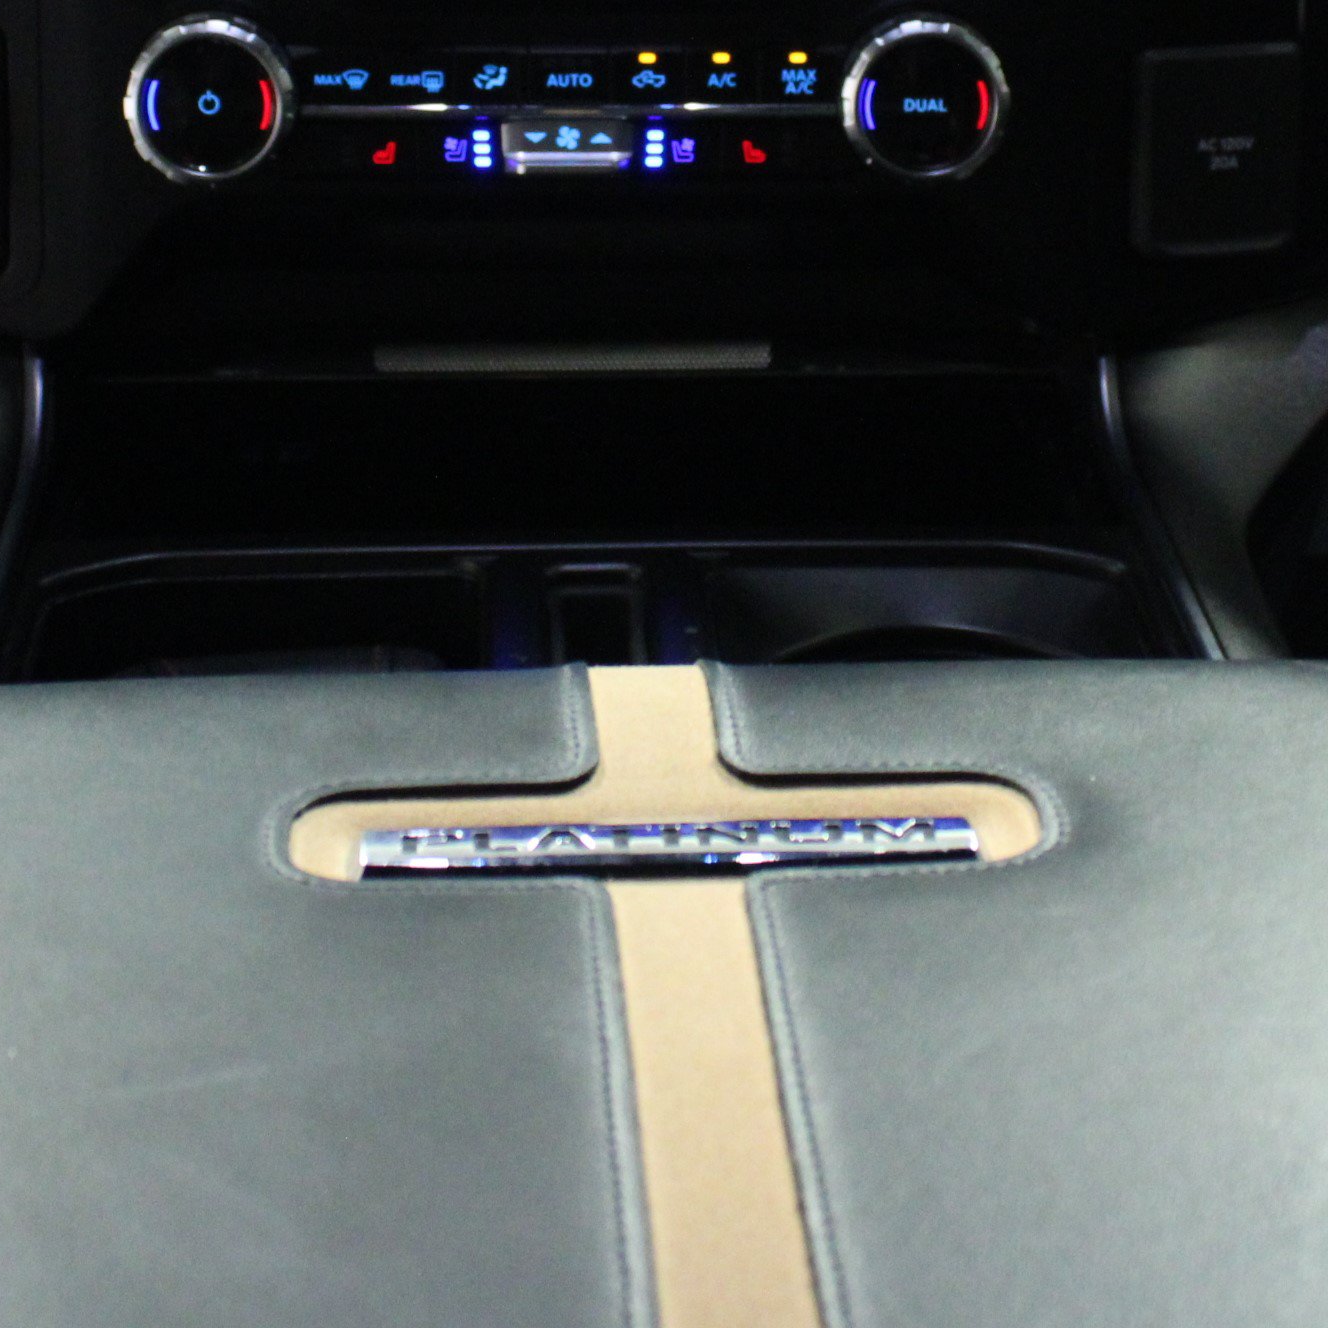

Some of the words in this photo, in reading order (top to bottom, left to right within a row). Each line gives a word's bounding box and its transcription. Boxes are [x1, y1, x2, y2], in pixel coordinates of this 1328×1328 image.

[313, 73, 342, 87] MAX
[390, 73, 421, 87] REAR
[546, 73, 593, 88] AUTO
[708, 73, 737, 89] A/C
[781, 69, 817, 83] MAX
[785, 81, 814, 95] A/C
[903, 98, 948, 113] DUAL
